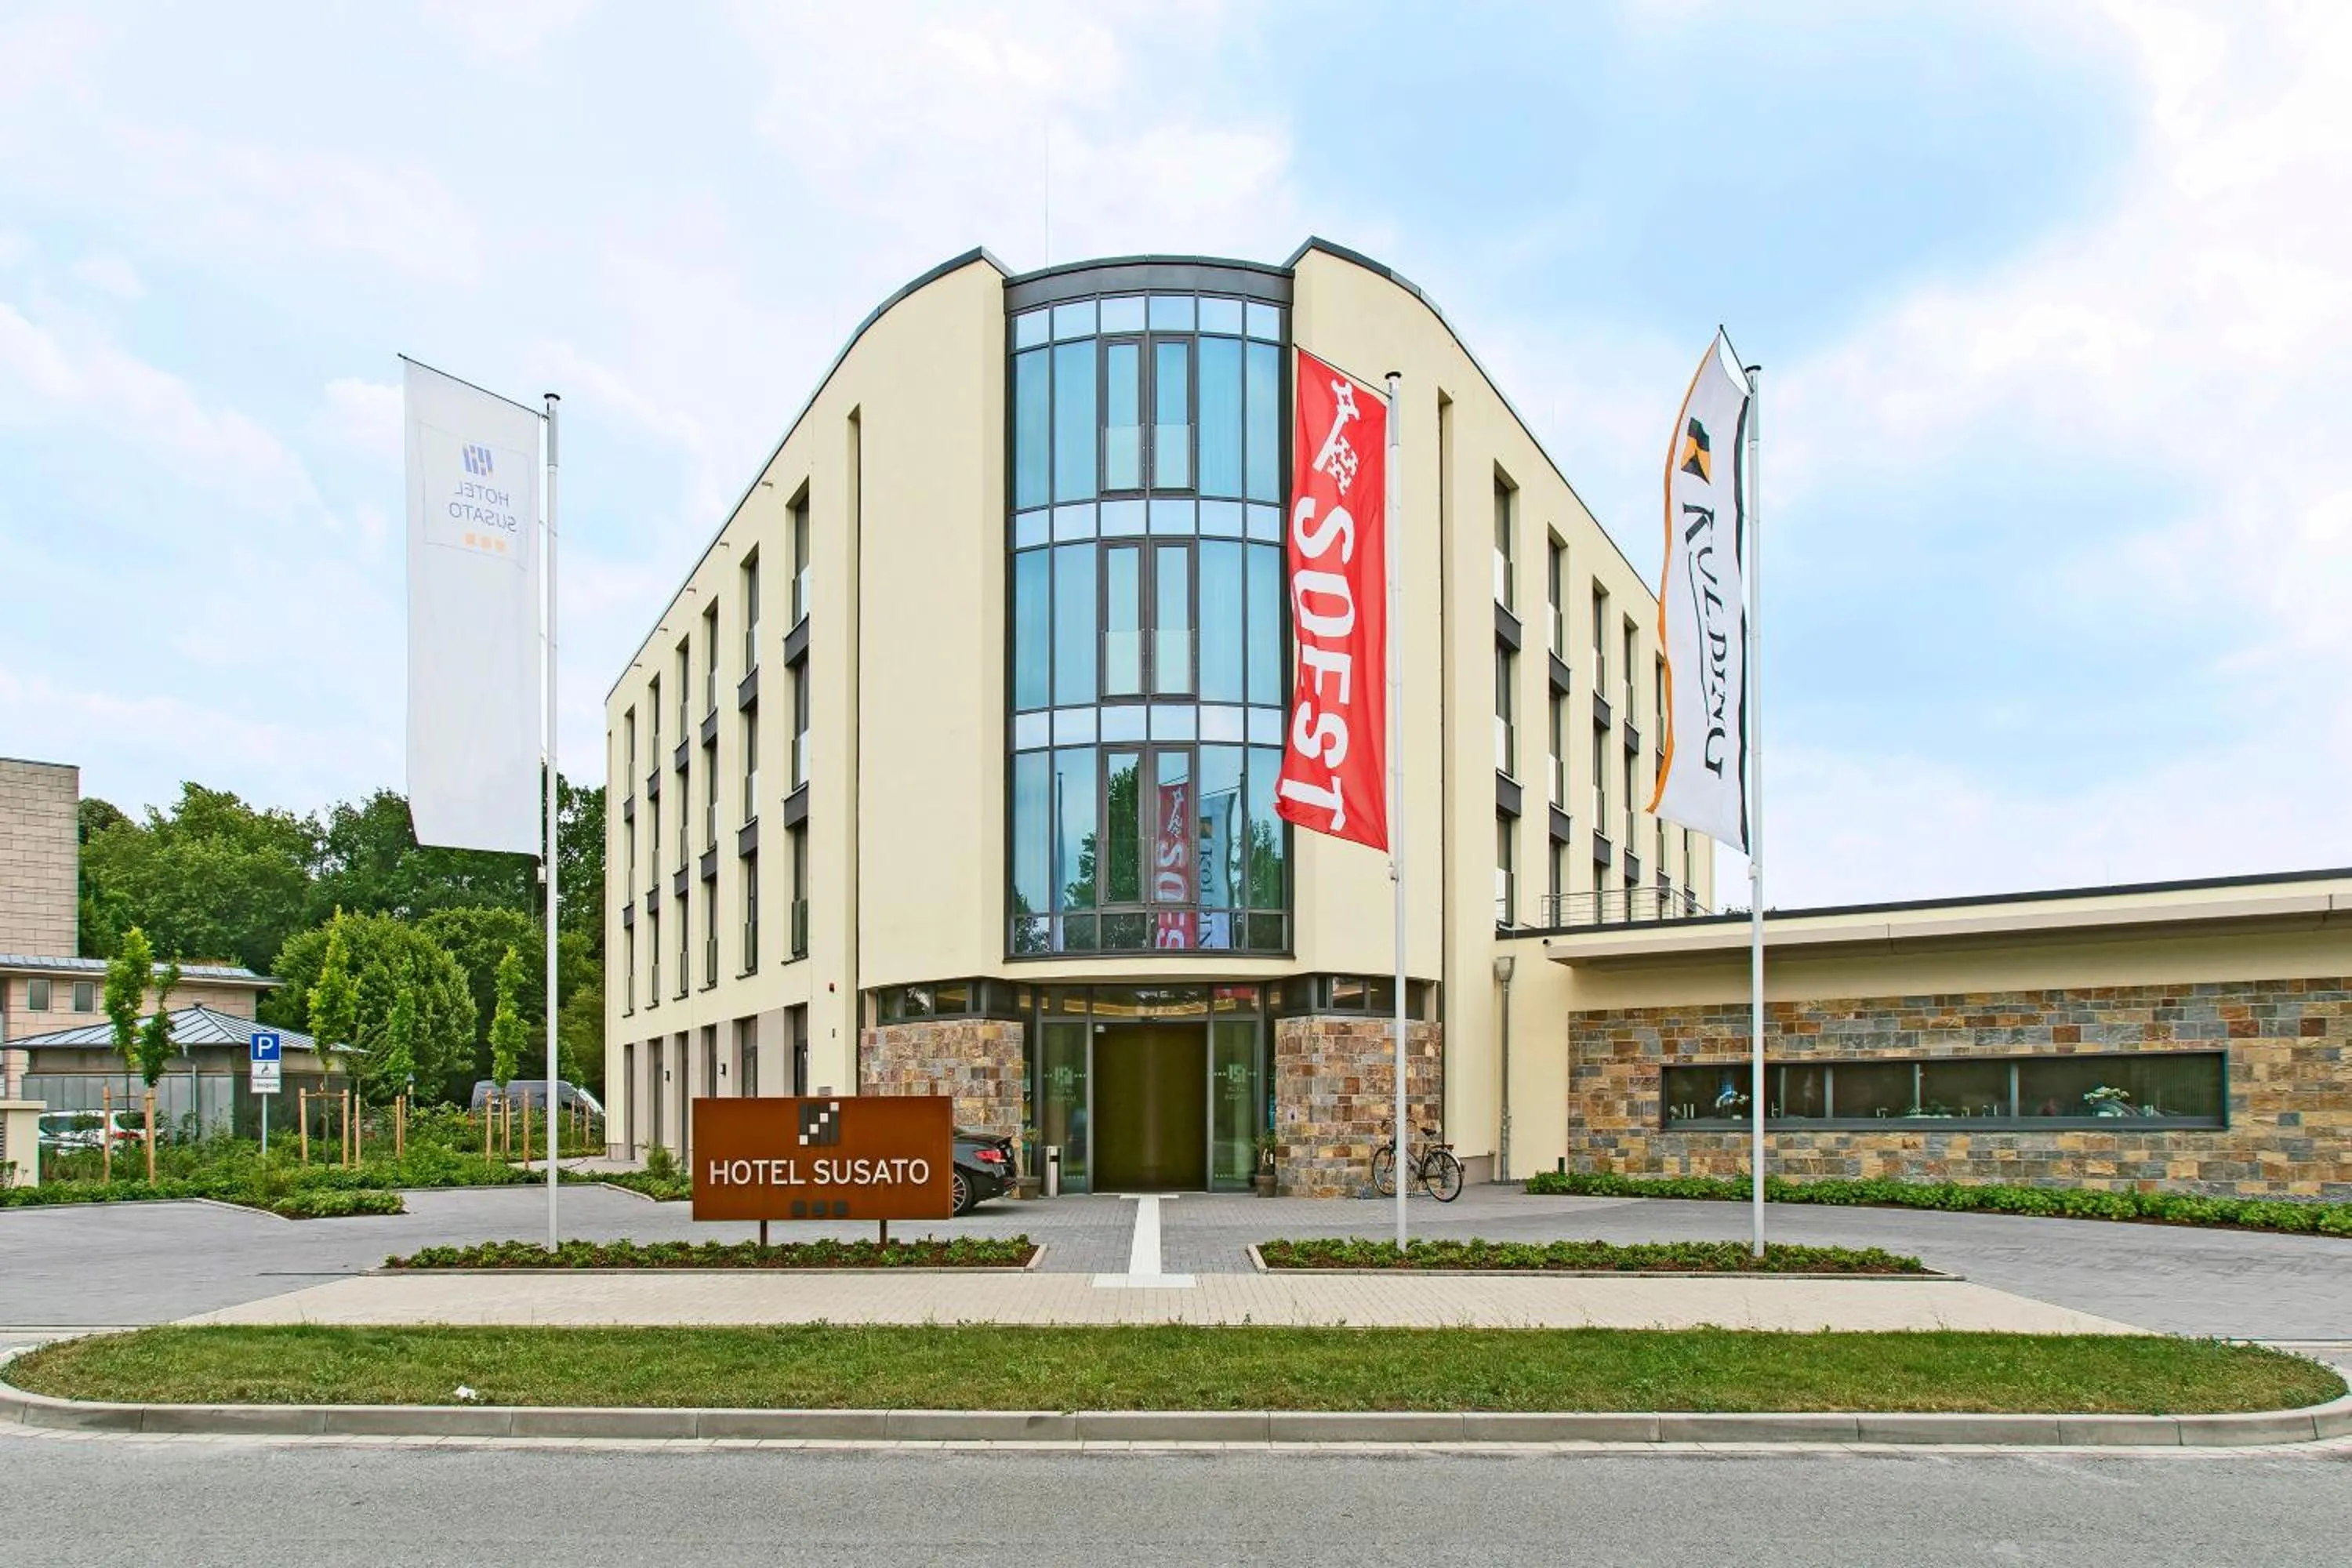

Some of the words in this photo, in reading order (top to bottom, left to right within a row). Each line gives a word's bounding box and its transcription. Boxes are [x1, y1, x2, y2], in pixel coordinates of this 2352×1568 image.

[258, 1036, 274, 1058] P
[710, 1160, 806, 1185] HOTEL
[813, 1158, 930, 1185] SUSATO
